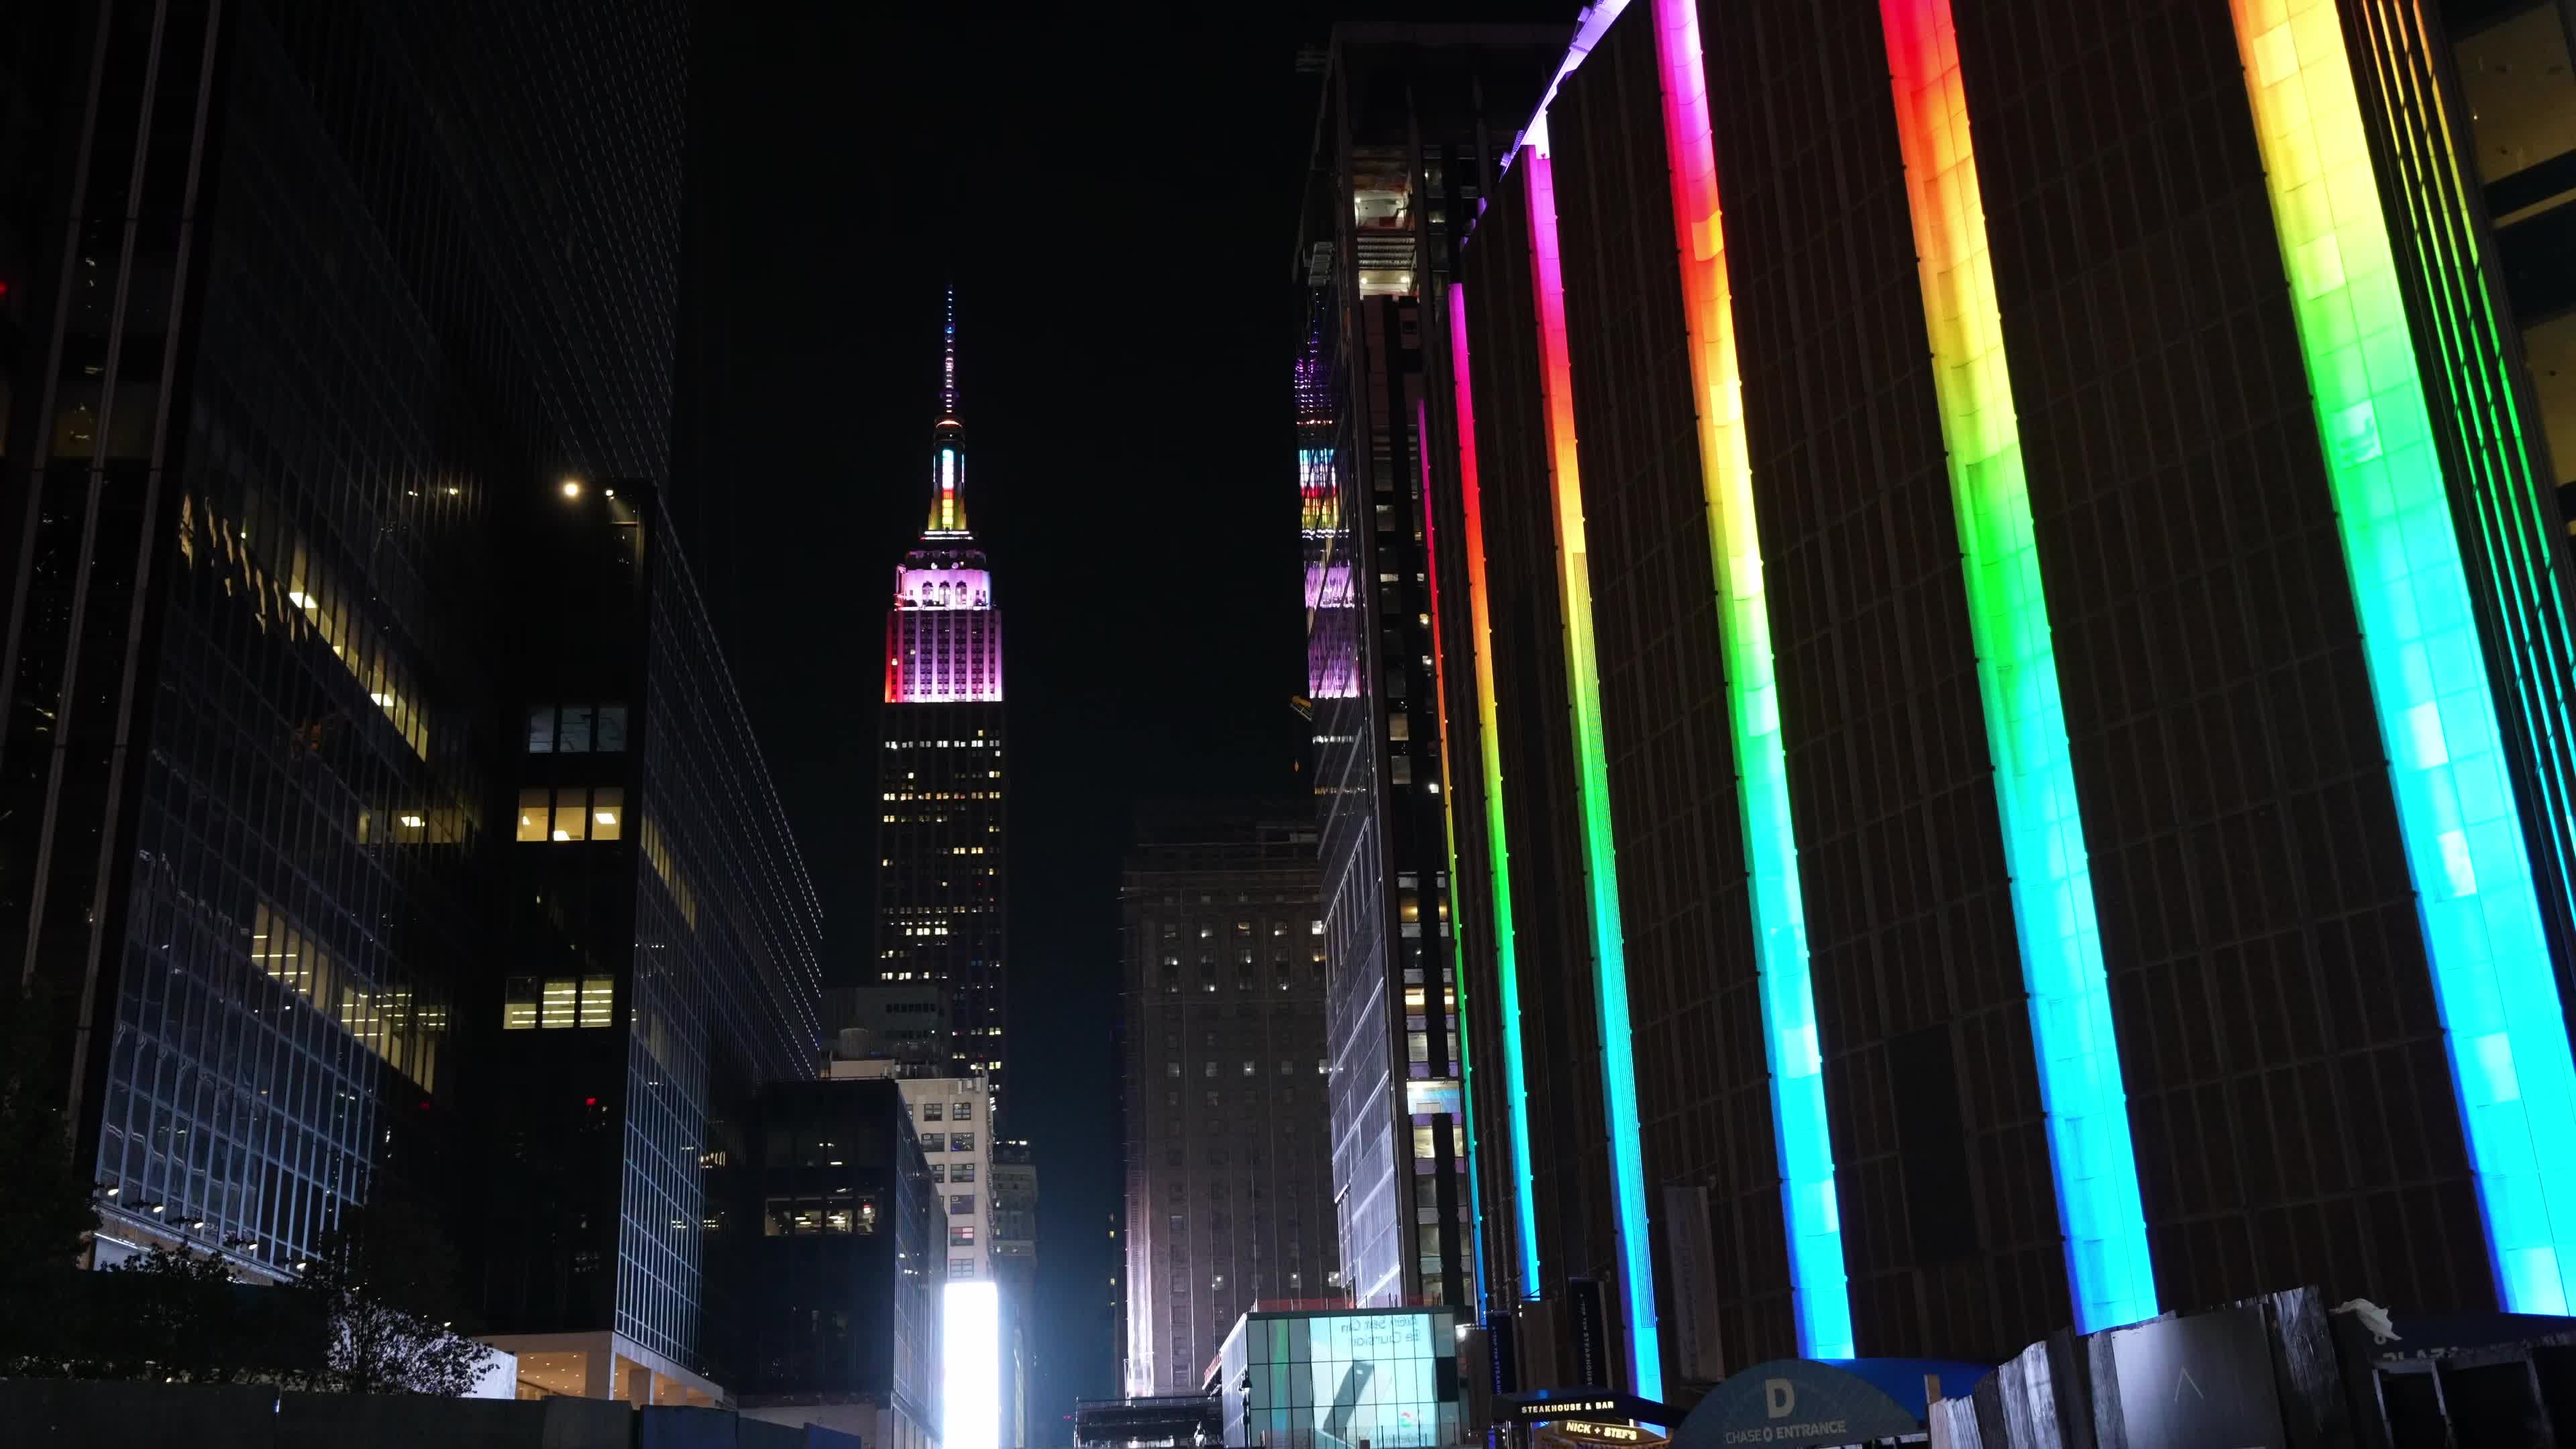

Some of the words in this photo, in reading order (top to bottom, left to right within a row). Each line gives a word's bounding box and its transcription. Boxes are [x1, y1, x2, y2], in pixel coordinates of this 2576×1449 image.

[1521, 1403, 1581, 1413] STEAKHOUSE
[1585, 1401, 1592, 1410] &
[1595, 1401, 1614, 1410] BAR
[1765, 1379, 1795, 1418] D
[1566, 1421, 1591, 1434] NICK
[1603, 1427, 1638, 1441] STEF'S
[1725, 1430, 1762, 1444] CHASE
[1775, 1420, 1847, 1439] ENTRANCE
